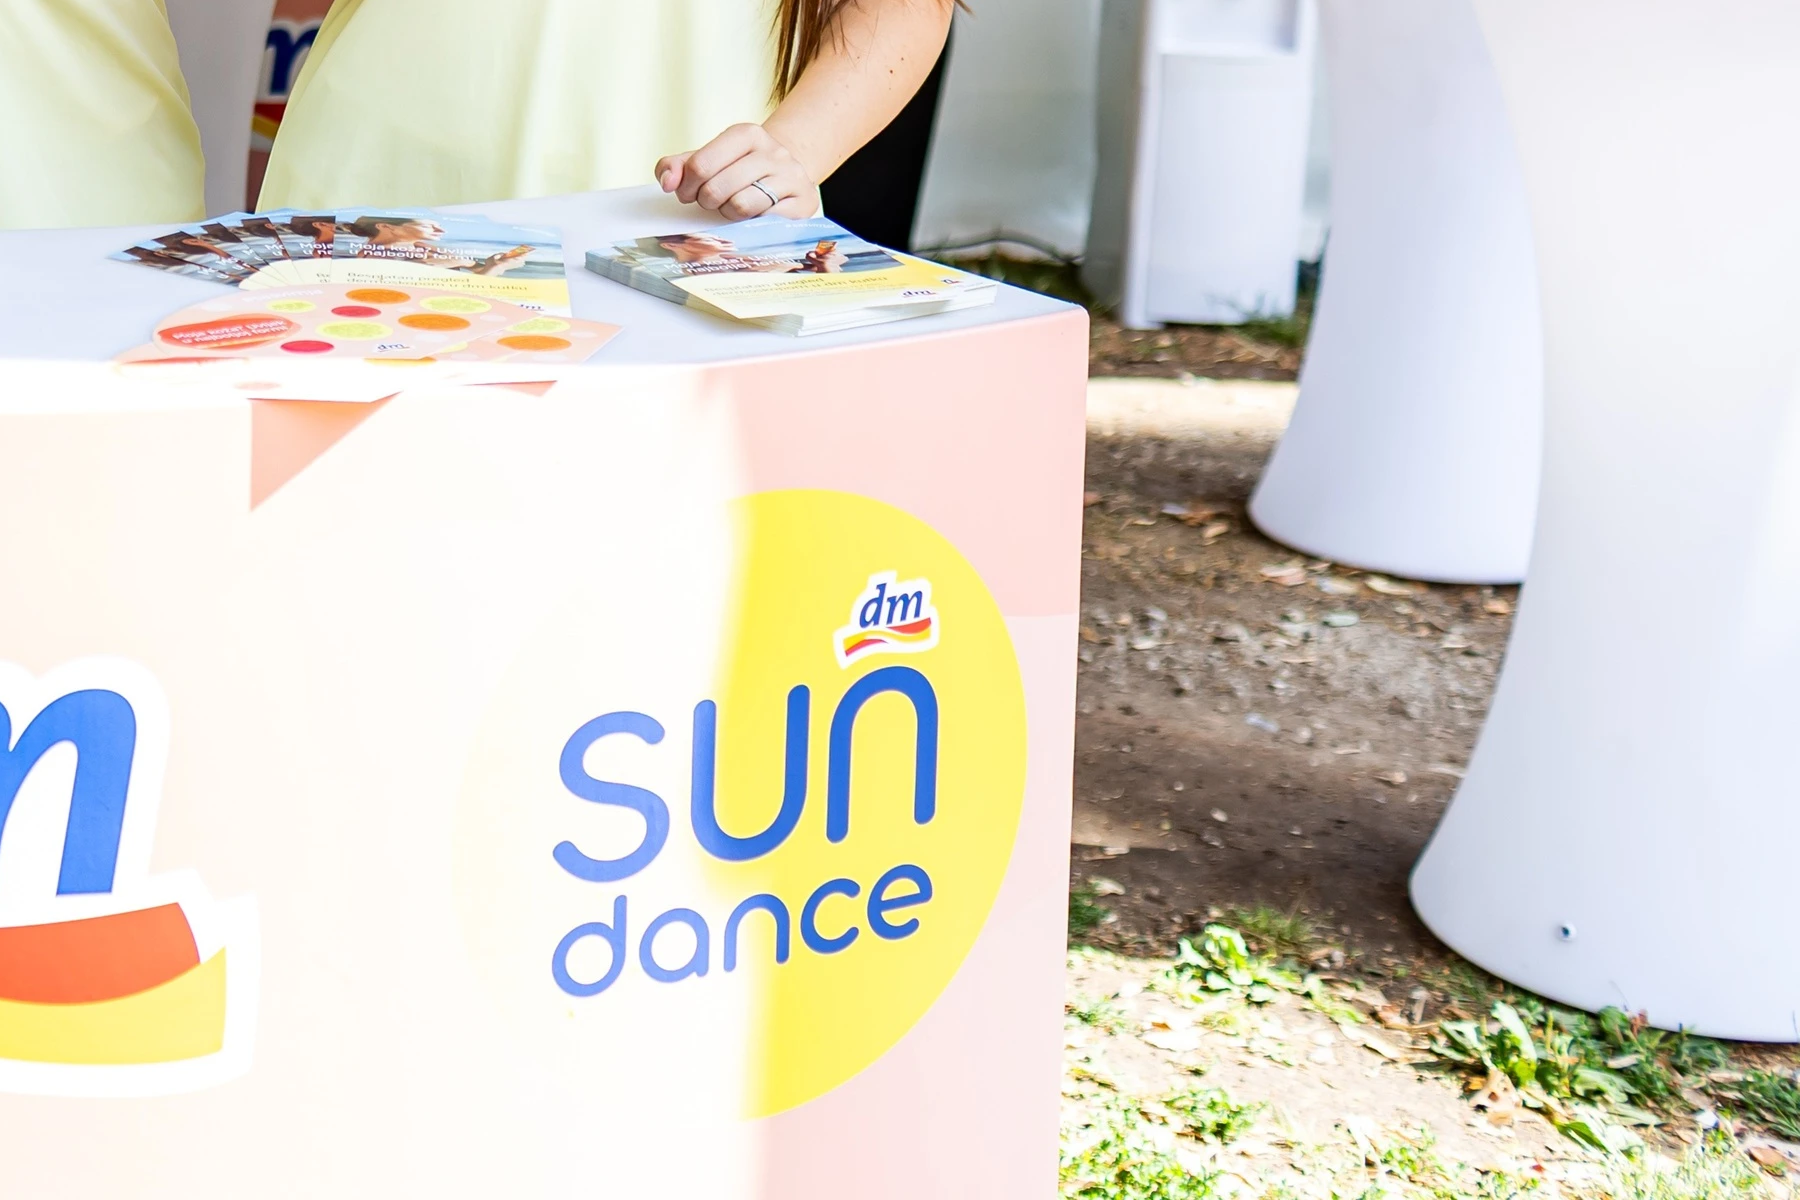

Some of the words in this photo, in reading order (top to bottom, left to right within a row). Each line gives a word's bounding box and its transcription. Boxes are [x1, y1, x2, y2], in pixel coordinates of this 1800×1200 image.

[350, 242, 387, 253] Moja
[417, 276, 470, 285] pregled
[858, 582, 924, 629] dm
[552, 665, 940, 884] sun
[552, 863, 933, 998] dance
